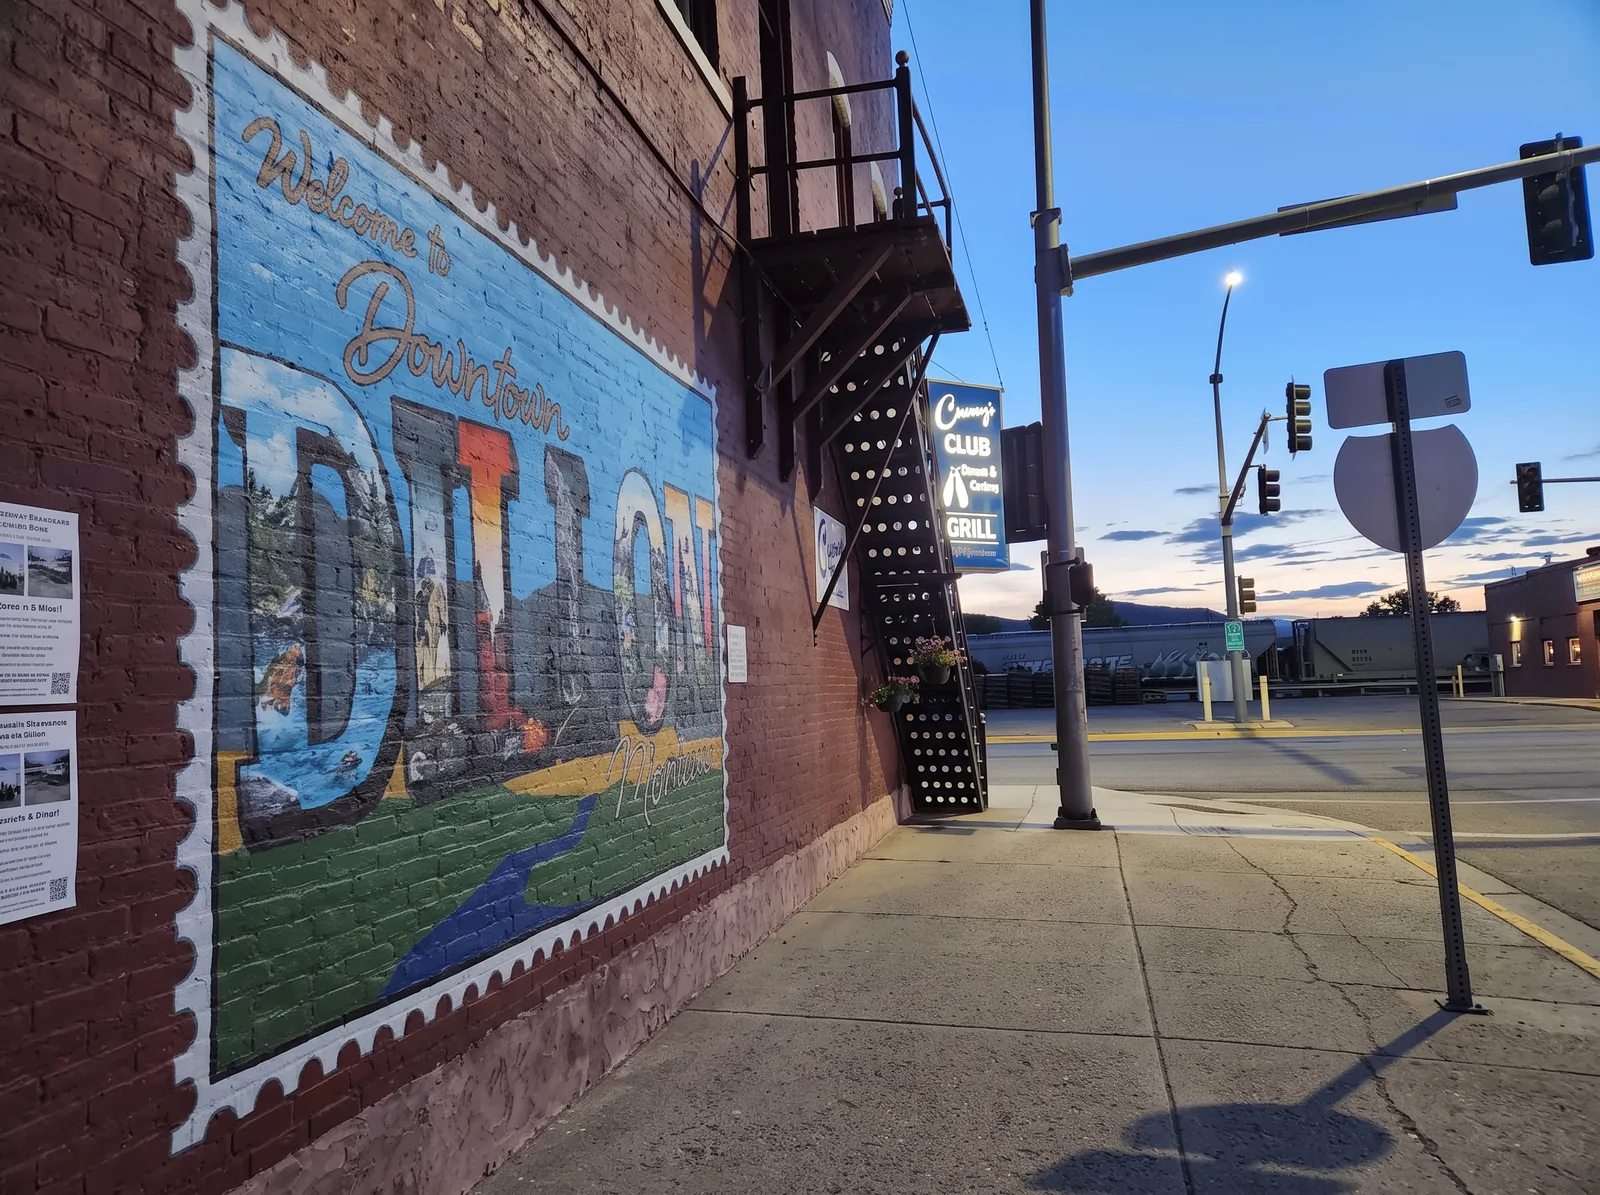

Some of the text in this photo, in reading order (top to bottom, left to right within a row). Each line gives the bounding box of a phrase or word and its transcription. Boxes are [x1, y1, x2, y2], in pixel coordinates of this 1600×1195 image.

[242, 115, 452, 277] Welcome to
[335, 260, 570, 440] Downtown
[944, 433, 991, 457] CLUB
[946, 517, 997, 540] GRILL
